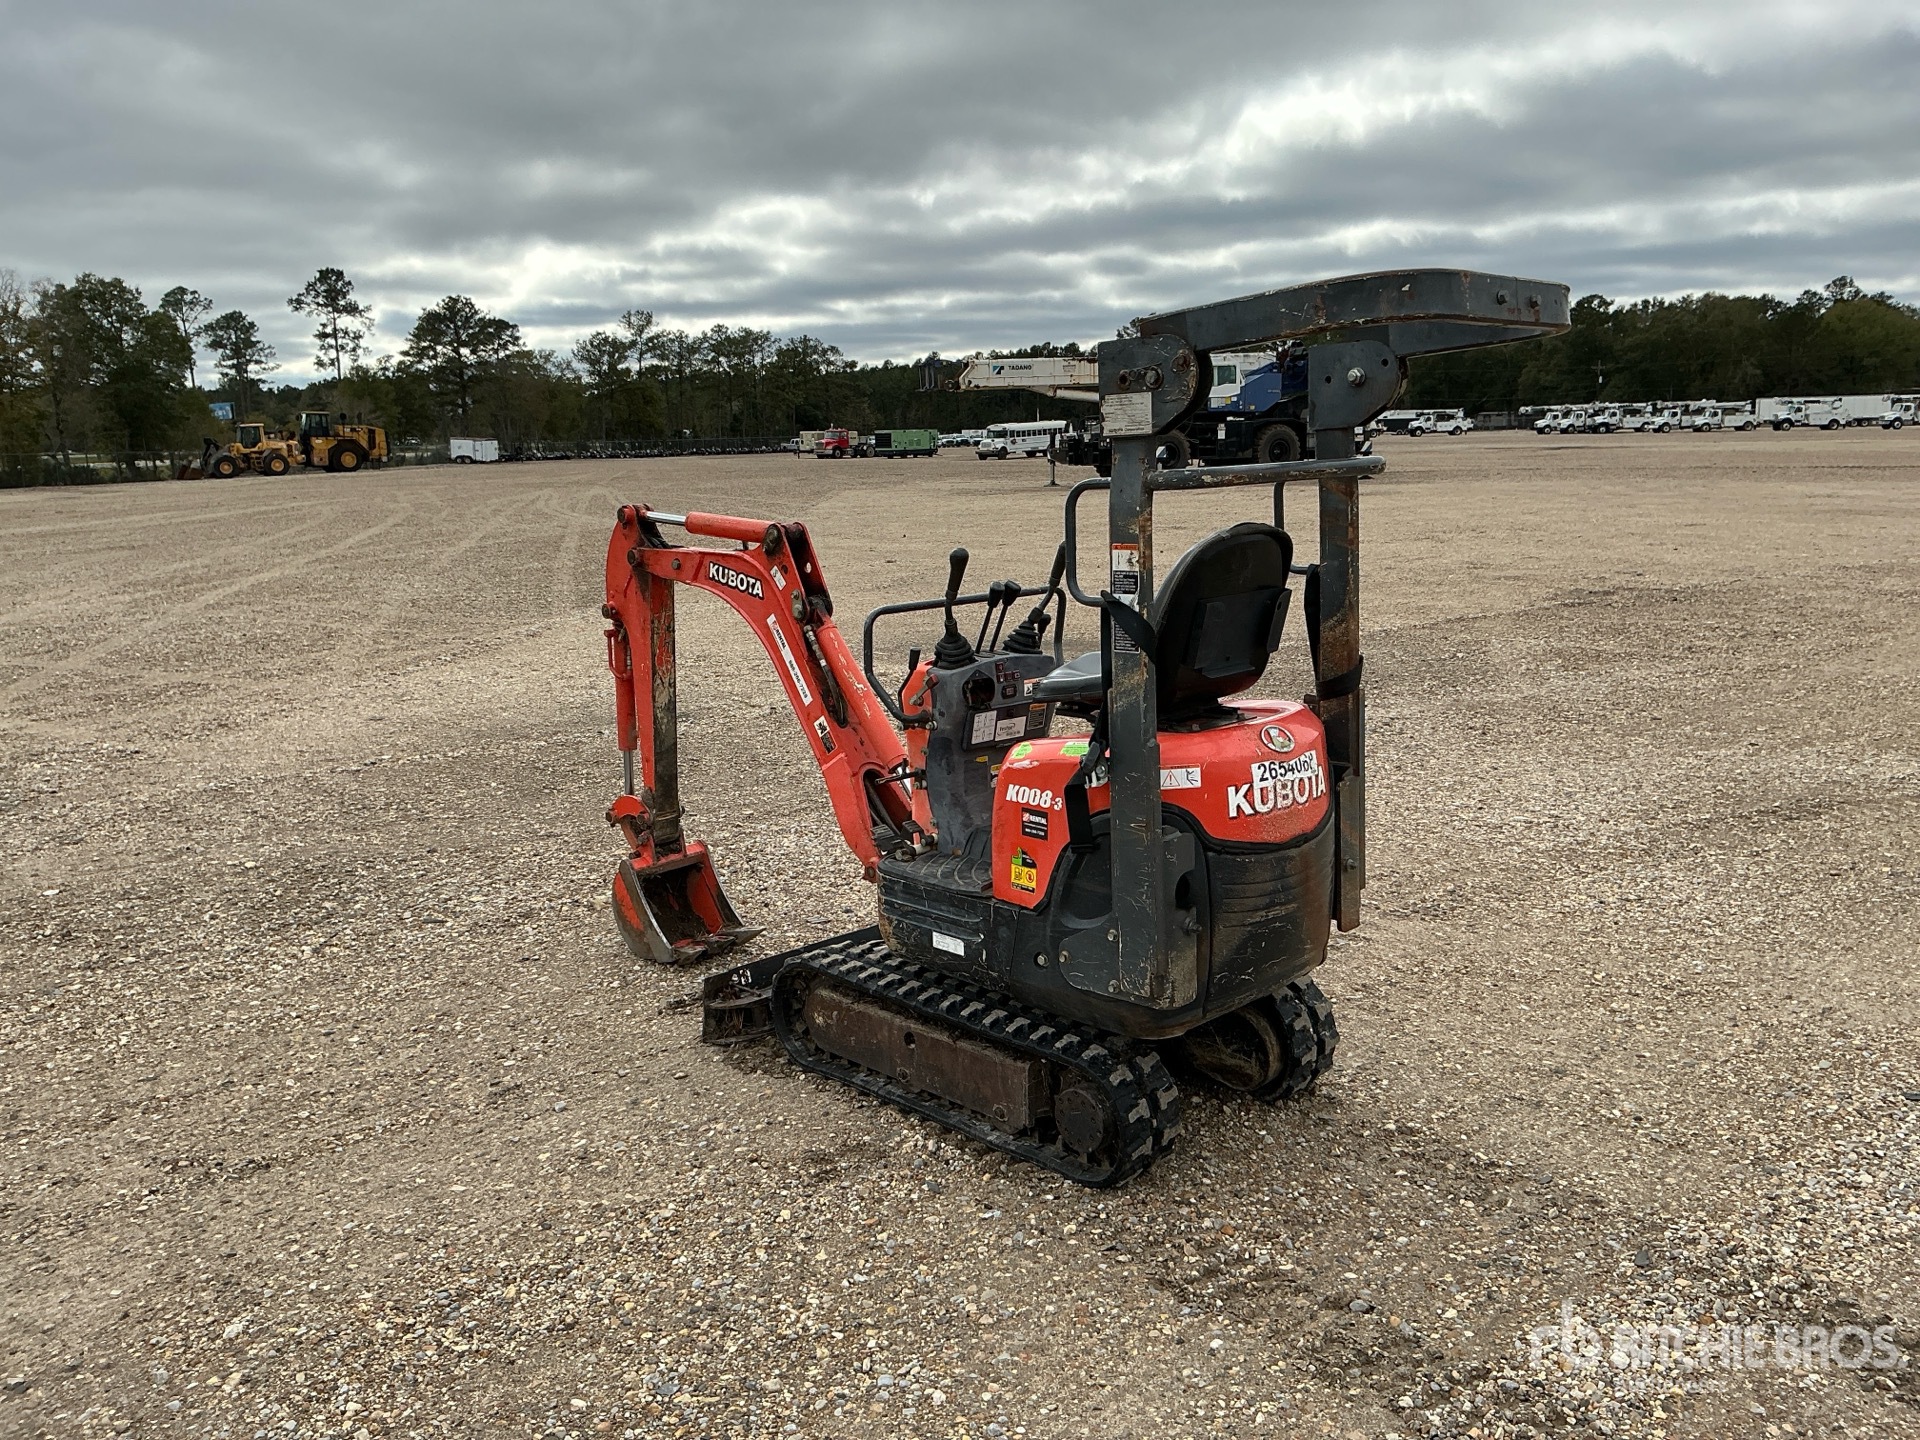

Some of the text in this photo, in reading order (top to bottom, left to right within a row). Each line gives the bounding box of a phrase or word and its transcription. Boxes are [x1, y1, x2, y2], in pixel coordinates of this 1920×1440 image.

[708, 562, 764, 598] KUBOTA
[1005, 783, 1063, 811] K008-3
[1227, 765, 1327, 818] KUBOTA
